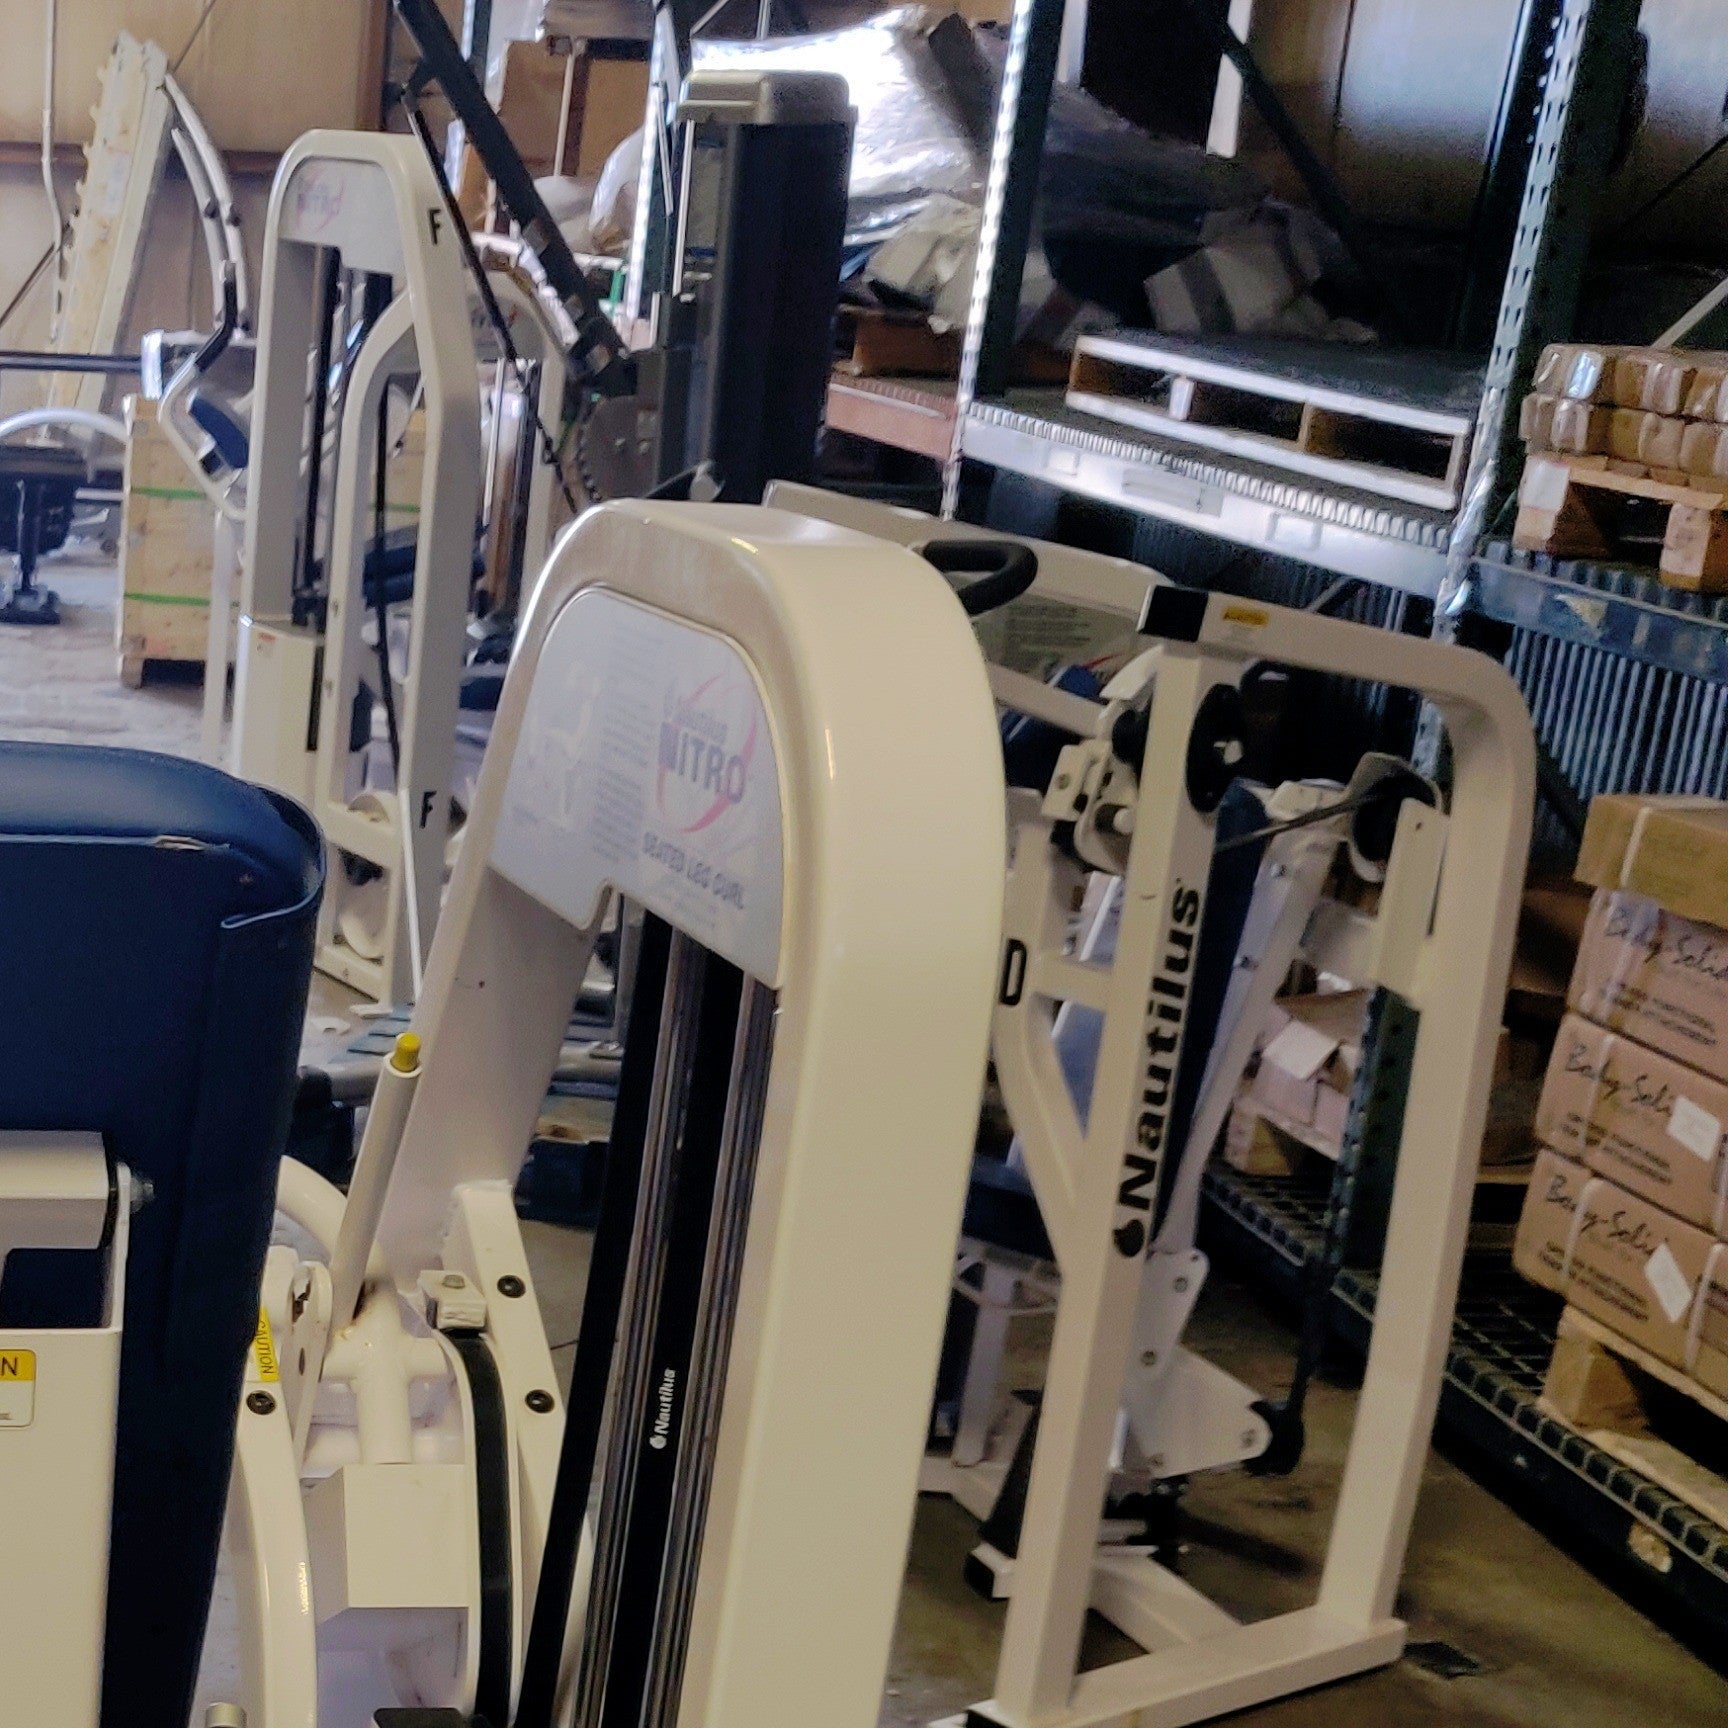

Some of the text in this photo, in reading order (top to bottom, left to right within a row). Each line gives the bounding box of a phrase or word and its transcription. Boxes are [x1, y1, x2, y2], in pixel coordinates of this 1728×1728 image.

[428, 208, 441, 245] F
[659, 720, 745, 805] NITRO
[420, 790, 438, 829] F
[997, 937, 1027, 1006] D
[1118, 886, 1200, 1211] Nautilus
[654, 1367, 676, 1435] Nautilus
